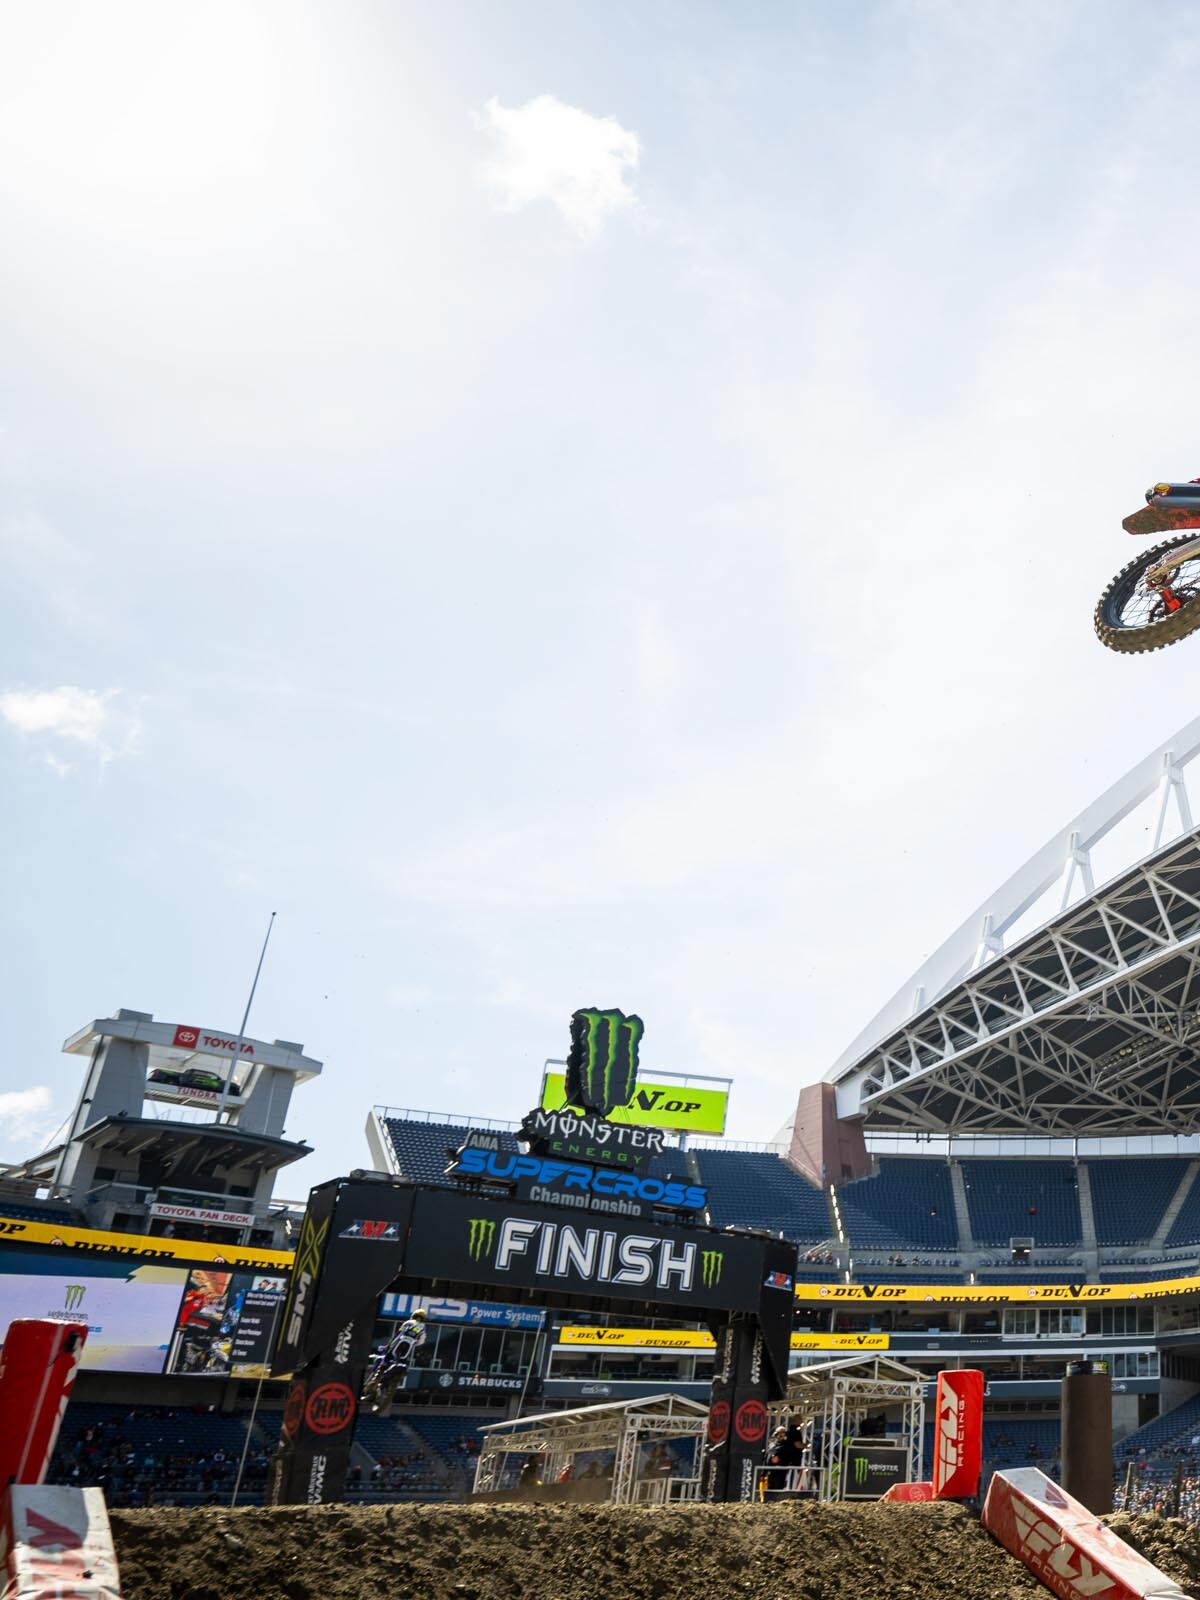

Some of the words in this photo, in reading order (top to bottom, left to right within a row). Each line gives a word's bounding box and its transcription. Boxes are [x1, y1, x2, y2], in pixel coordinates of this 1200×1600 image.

[203, 1036, 254, 1055] TOYOTA
[177, 1086, 218, 1100] TUNDRA
[469, 1131, 499, 1151] AMA
[552, 1141, 644, 1164] ENERGY
[457, 1149, 709, 1209] SUPERCROSS
[530, 1185, 642, 1217] Championship
[156, 1205, 196, 1218] TOYOTA
[200, 1209, 219, 1220] FAN
[222, 1212, 250, 1224] DECK
[494, 1217, 698, 1292] FINISH
[470, 1306, 501, 1322] Power
[505, 1309, 546, 1325] Systems
[458, 1376, 523, 1389] STARBUCKS
